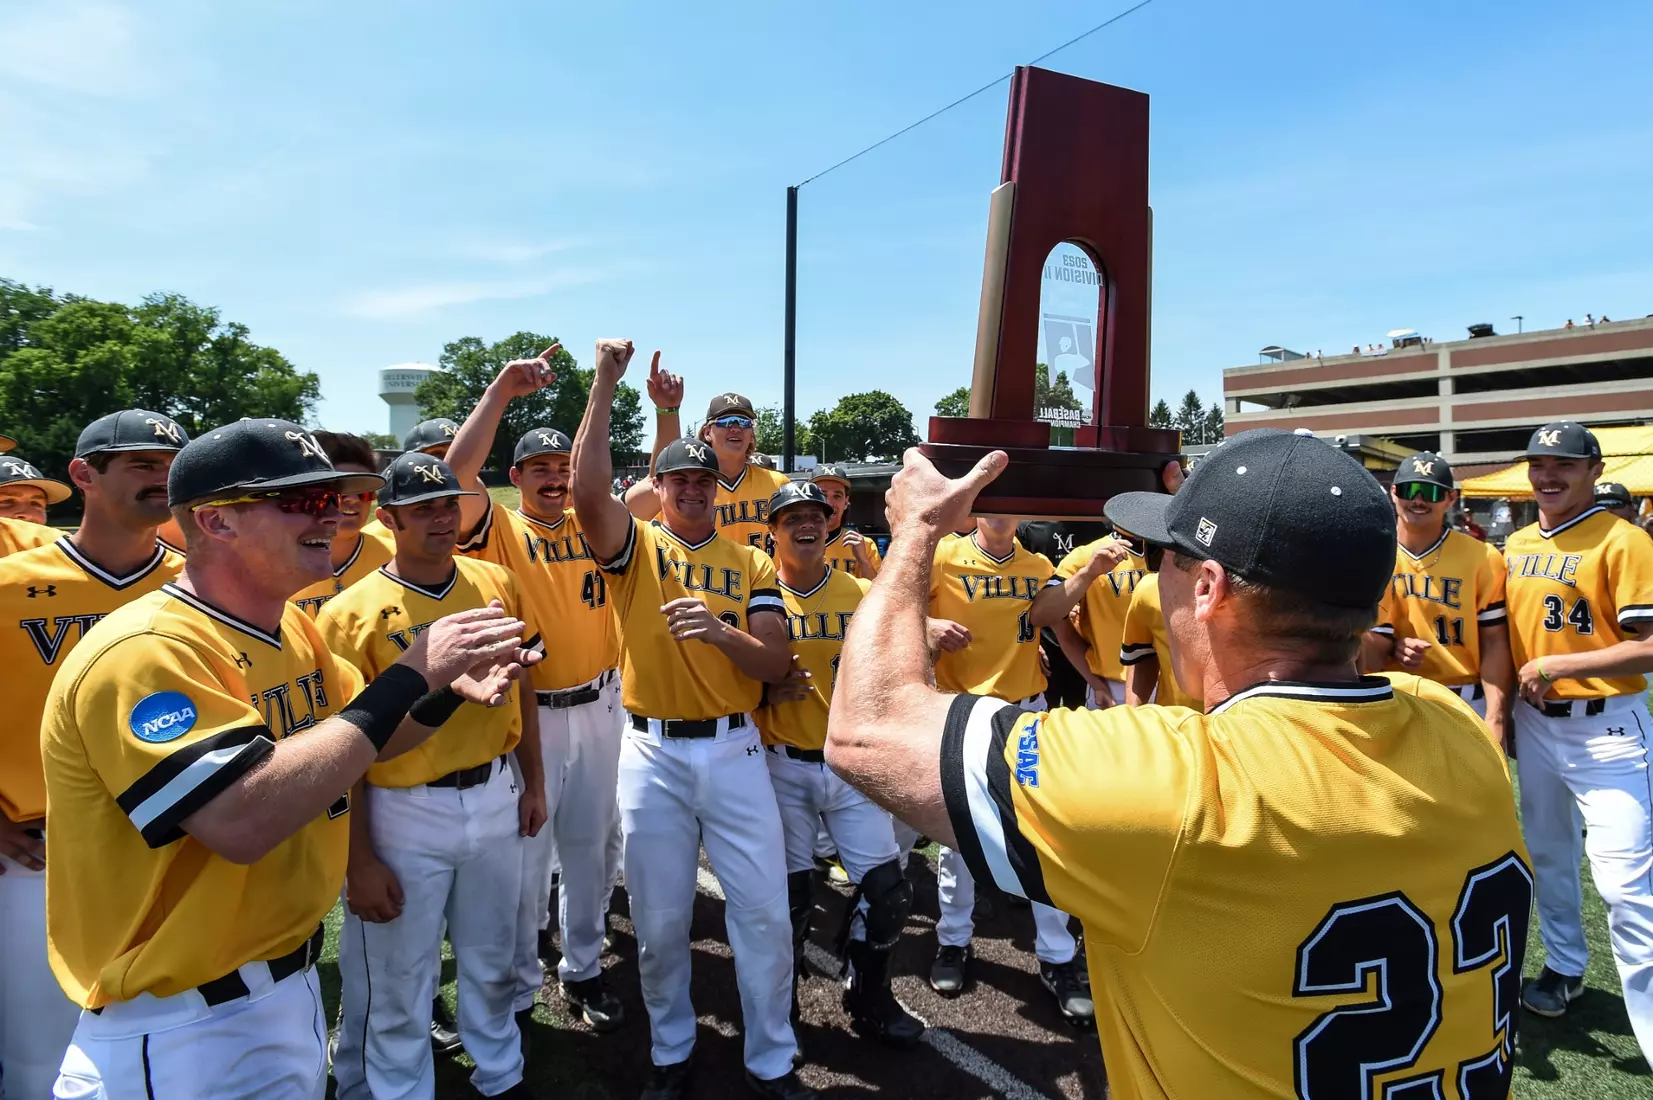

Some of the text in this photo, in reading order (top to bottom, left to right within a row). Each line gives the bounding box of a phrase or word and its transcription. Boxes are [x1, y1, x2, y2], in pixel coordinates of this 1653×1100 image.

[581, 568, 606, 610] 41
[656, 546, 743, 603] VILLE
[1434, 614, 1464, 646] 11
[1543, 594, 1594, 635] 34
[142, 707, 196, 736] NCAA
[1292, 849, 1534, 1100] 23
